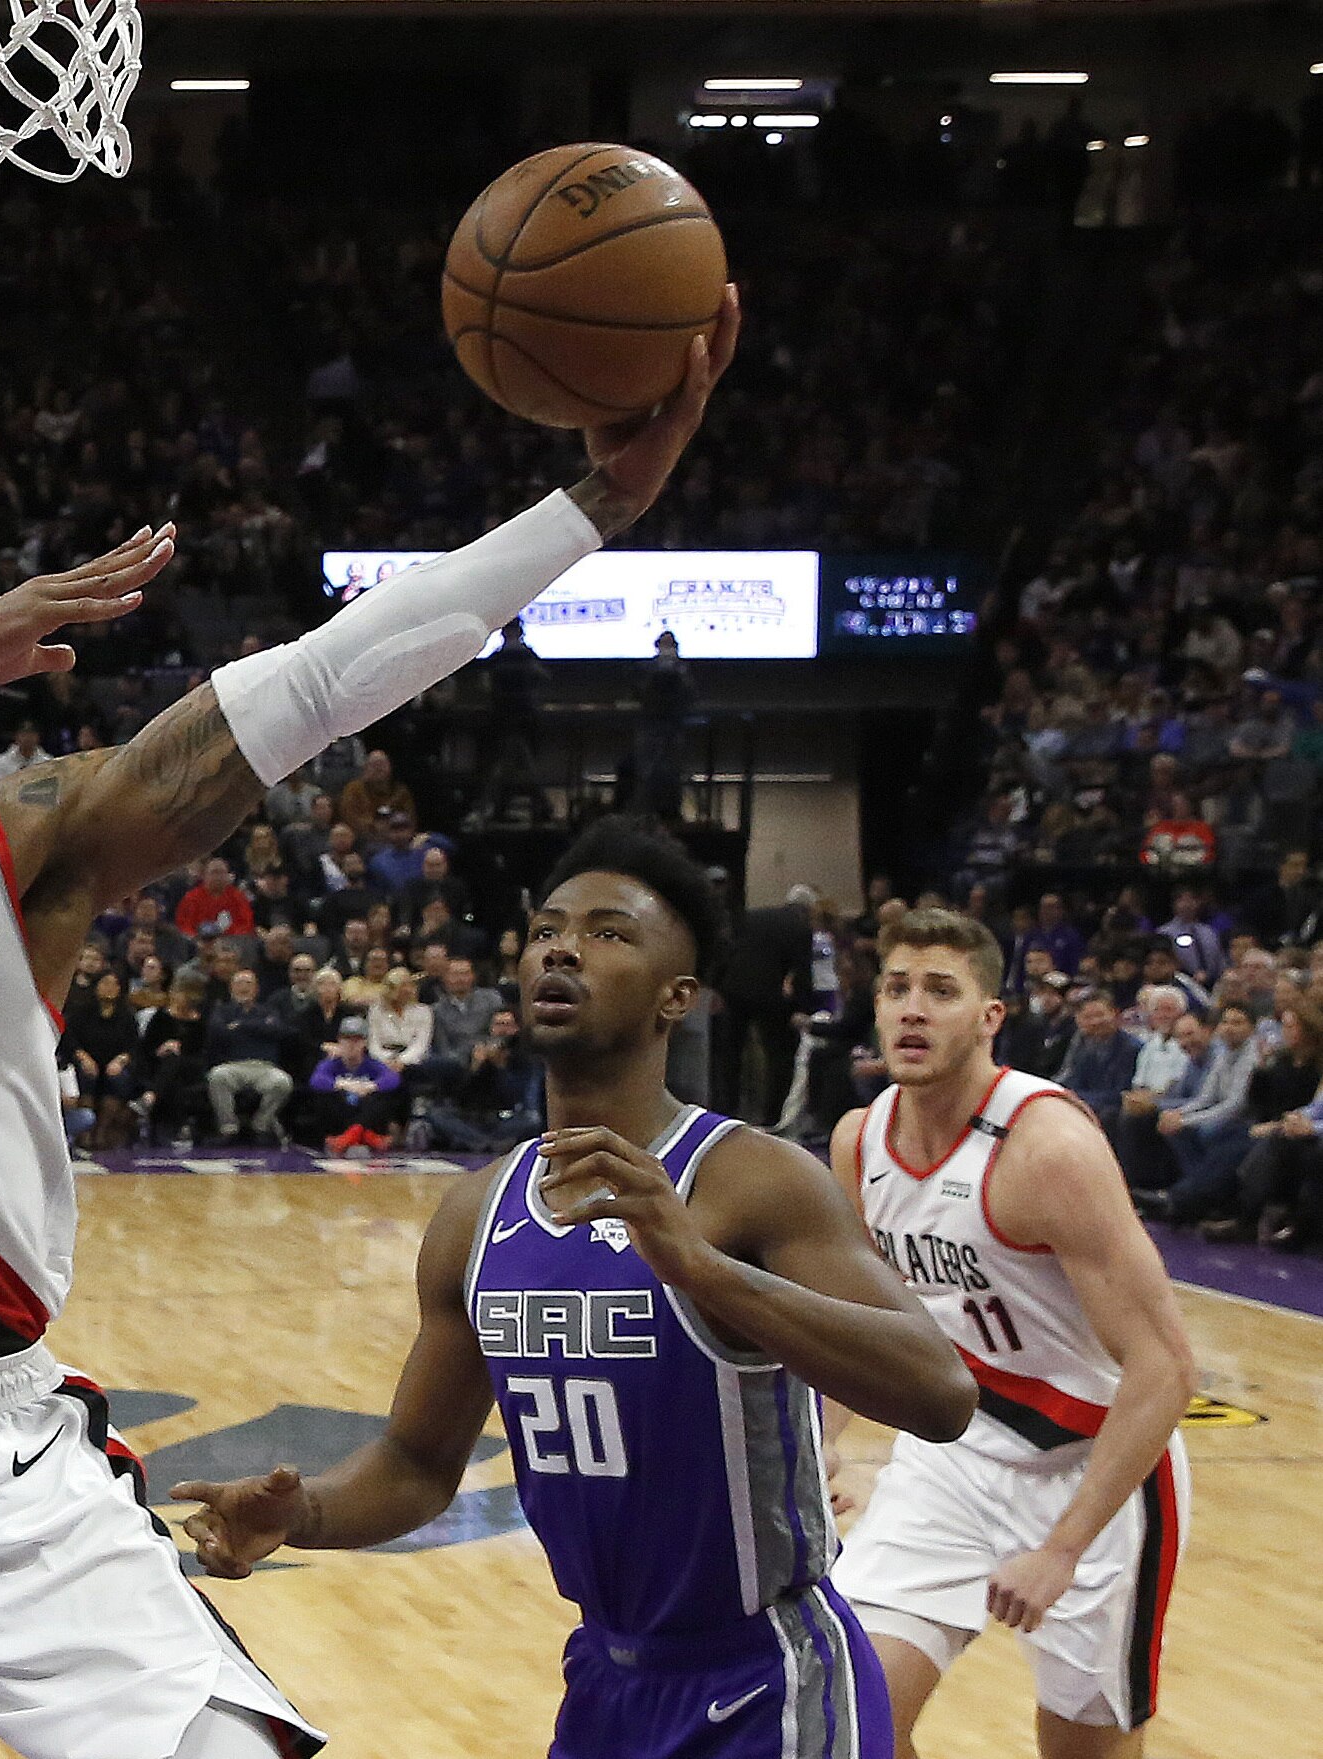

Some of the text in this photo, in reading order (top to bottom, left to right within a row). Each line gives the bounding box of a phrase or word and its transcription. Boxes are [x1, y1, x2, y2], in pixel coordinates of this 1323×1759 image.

[477, 1289, 657, 1358] SAC
[963, 1297, 1023, 1352] 11
[506, 1376, 628, 1478] 20
